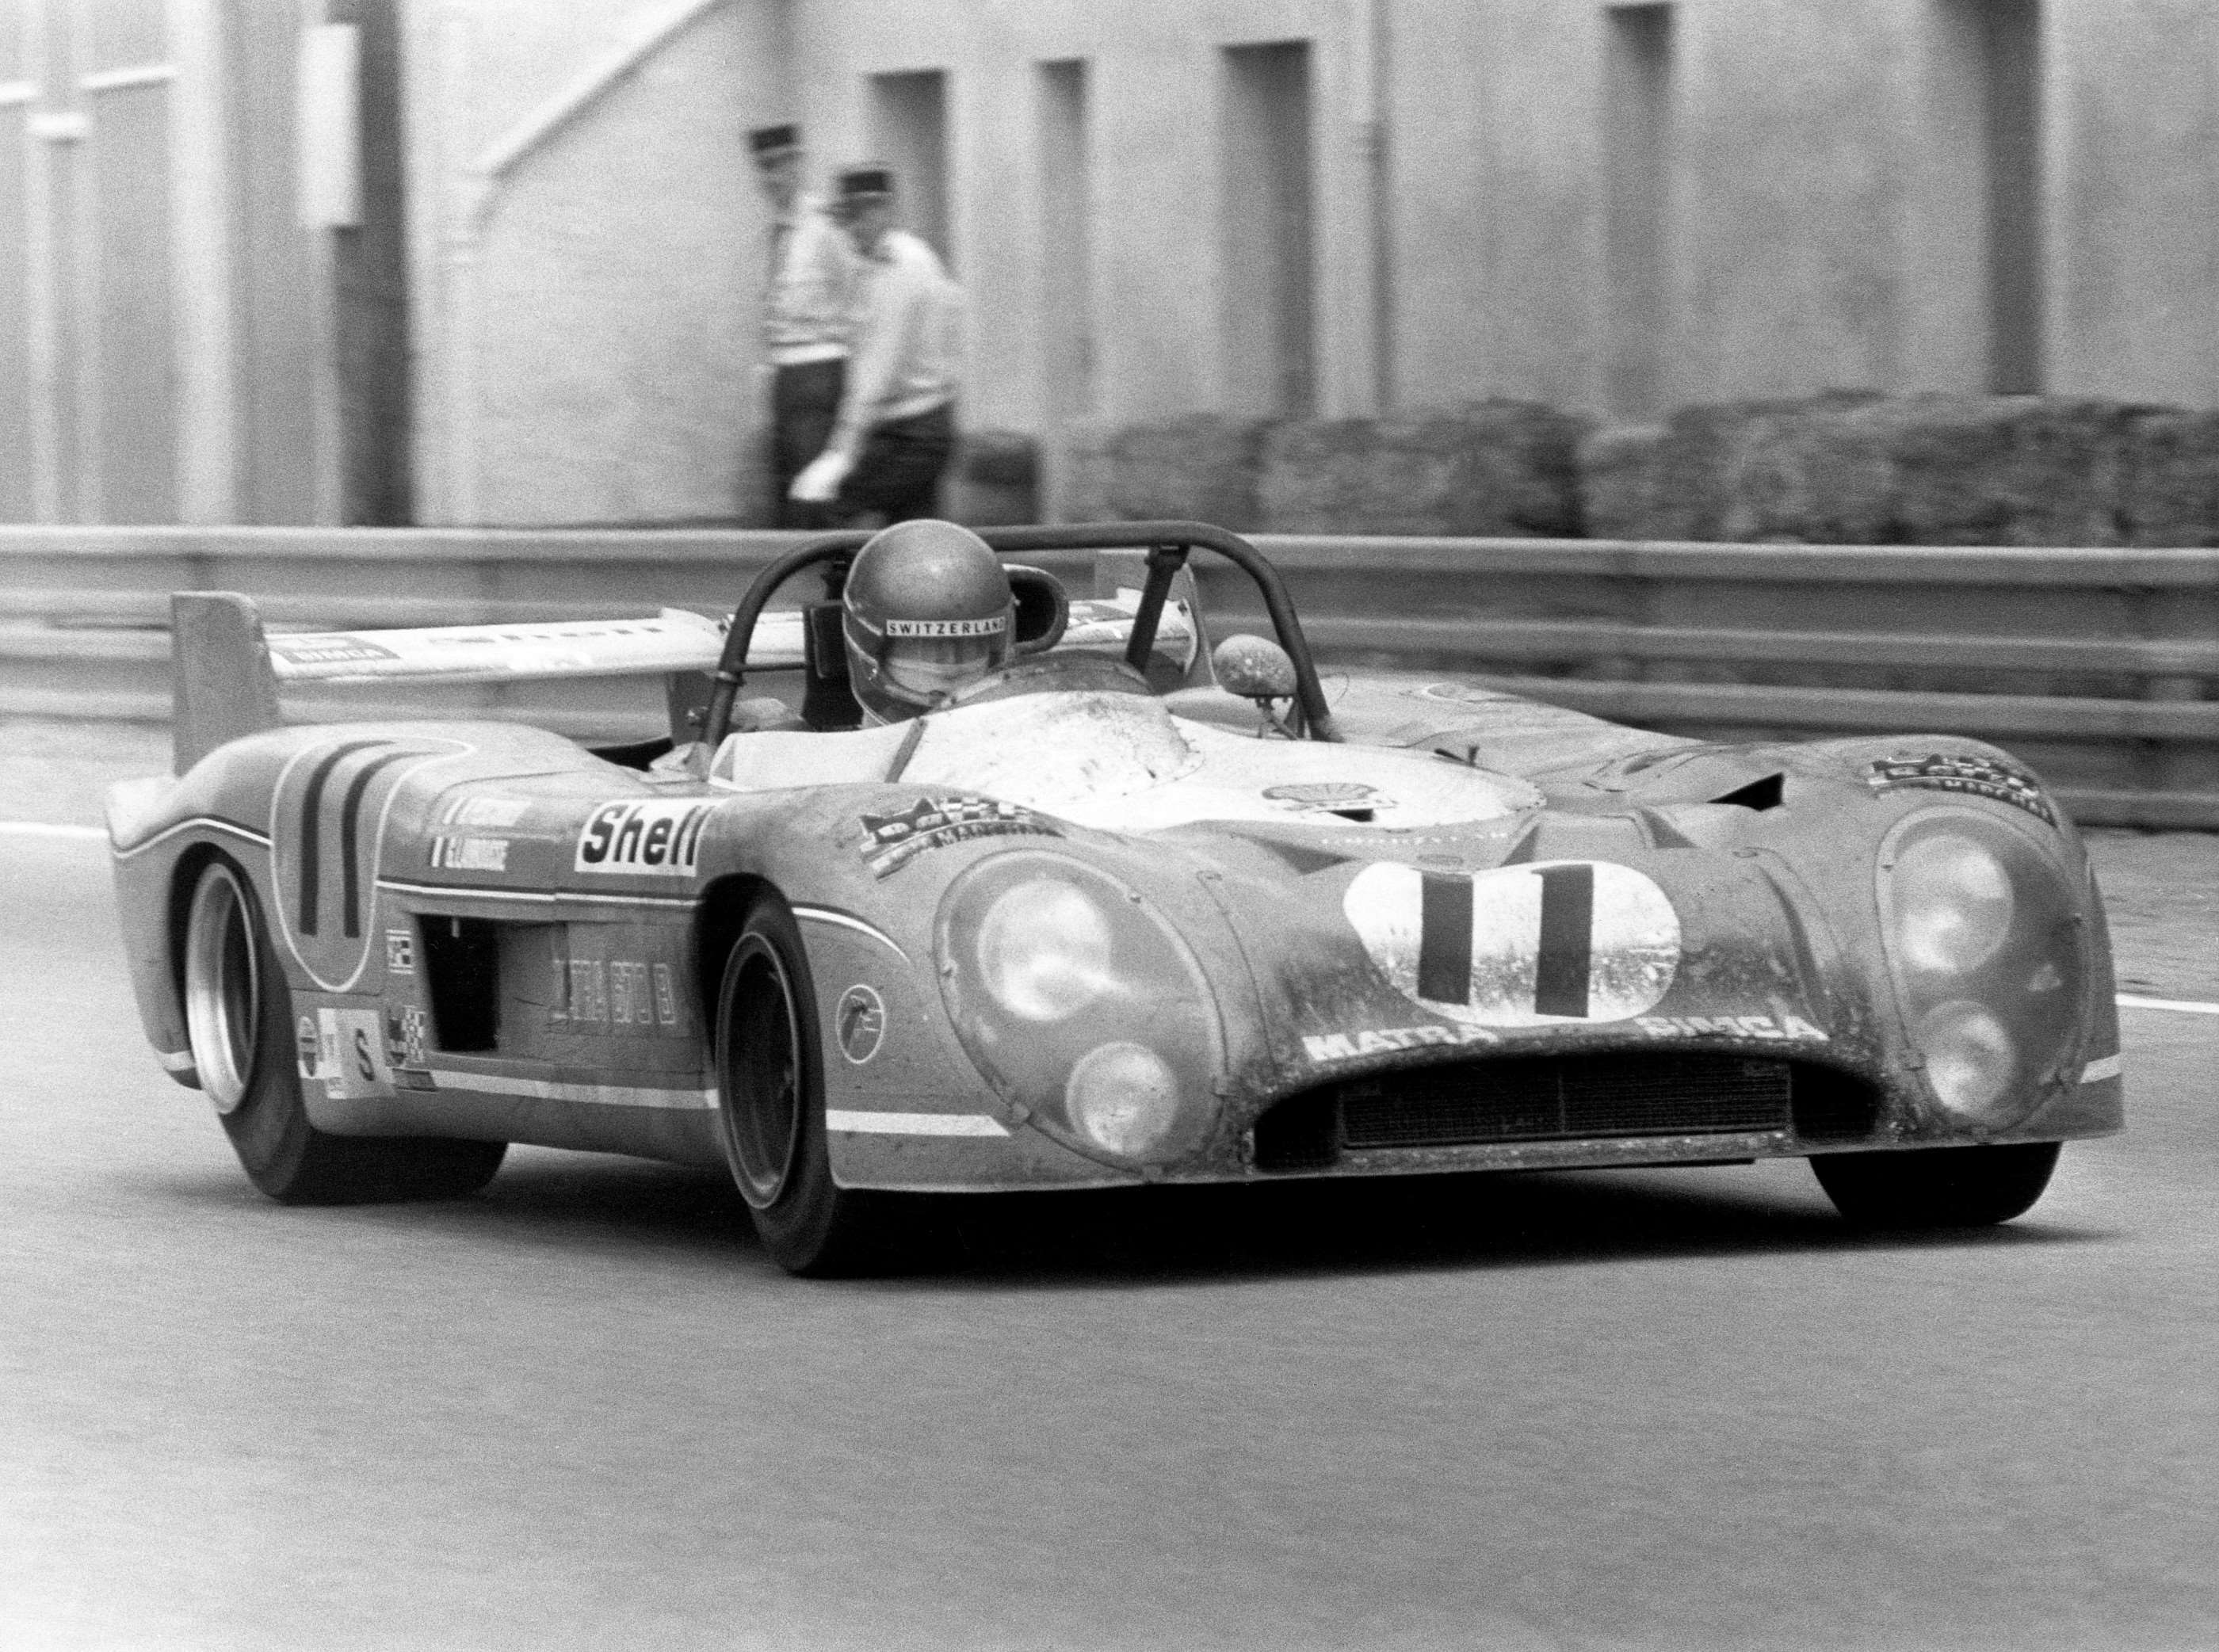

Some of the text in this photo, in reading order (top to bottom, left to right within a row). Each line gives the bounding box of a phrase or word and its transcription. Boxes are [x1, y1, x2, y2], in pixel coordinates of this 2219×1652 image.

[299, 740, 442, 938] 11
[582, 804, 715, 866] Shell
[1418, 864, 1594, 1018] 11
[1302, 1016, 1829, 1061] MATRA SIMCA
